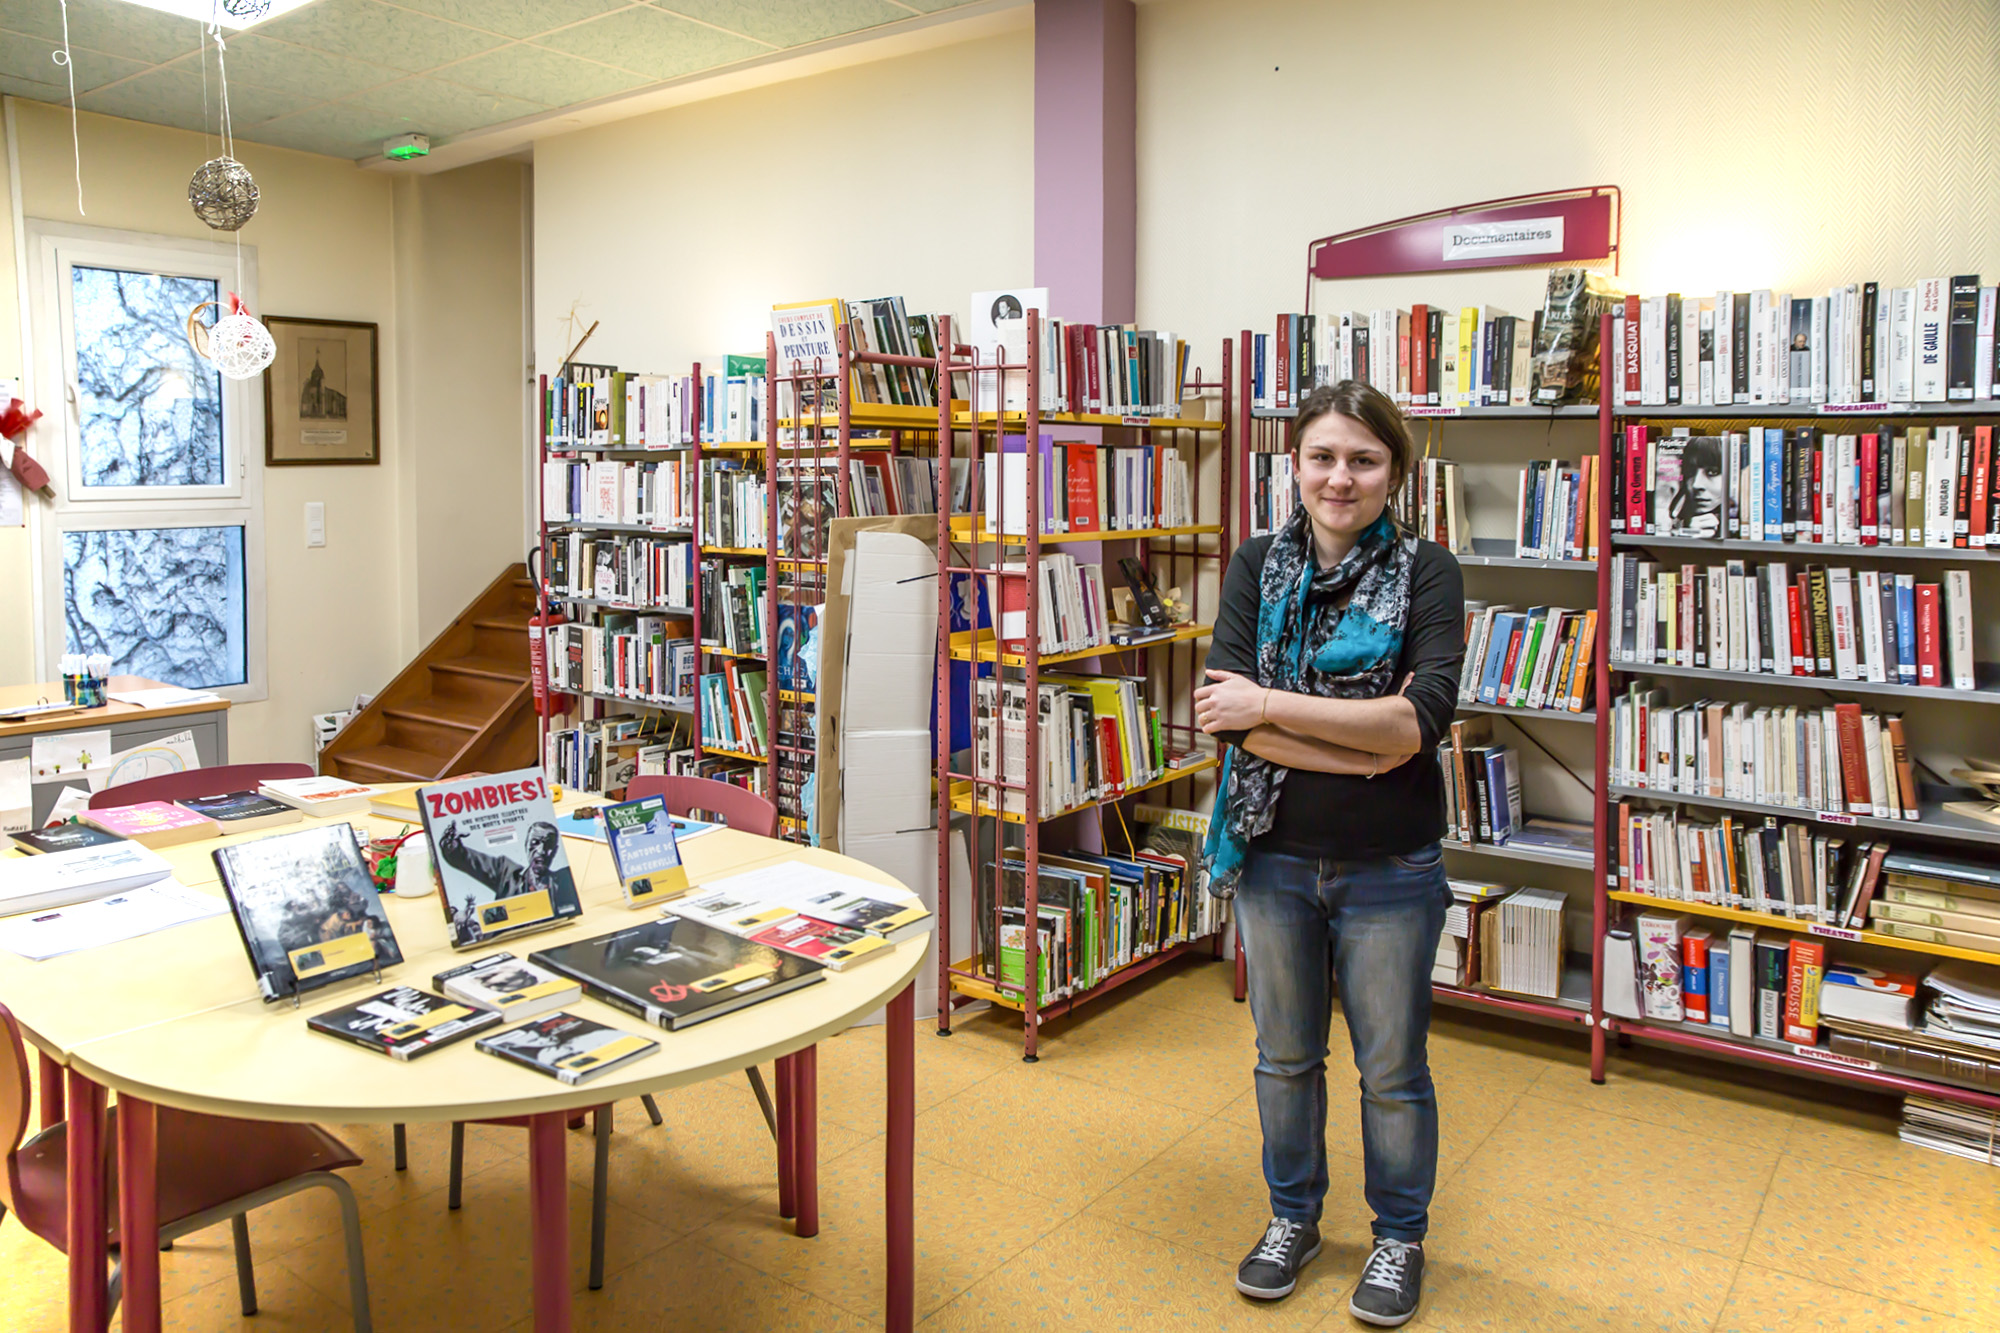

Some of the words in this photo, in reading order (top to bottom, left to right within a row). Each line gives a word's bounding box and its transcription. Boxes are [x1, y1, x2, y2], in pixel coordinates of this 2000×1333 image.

[1452, 227, 1552, 247] Documentaires
[780, 320, 825, 337] DESSIN
[1924, 323, 1938, 351] GAULLE
[784, 341, 830, 358] PEINTURE
[1627, 320, 1638, 374] BASQUIAT
[1669, 353, 1678, 378] GILBERT
[1923, 354, 1937, 364] DE
[1823, 402, 1888, 413] BIOGRAPHIES
[1631, 456, 1641, 487] Guevara
[1767, 460, 1780, 495] Fayette
[1631, 489, 1641, 504] Che
[1940, 479, 1949, 516] NOUGARO
[1811, 577, 1827, 615] TYSON
[426, 776, 546, 818] ZOMBIES!
[475, 814, 499, 823] HISTOIRE
[608, 806, 638, 818] Oscar
[611, 815, 640, 828] Wilde
[470, 823, 481, 831] DES
[482, 820, 501, 829] MORTS
[502, 816, 525, 825] VIVANTS
[1641, 921, 1672, 930] LAROUSSE
[1788, 965, 1802, 1019] LAROUSSE
[1799, 1047, 1871, 1068] DICTIONNAIRES
